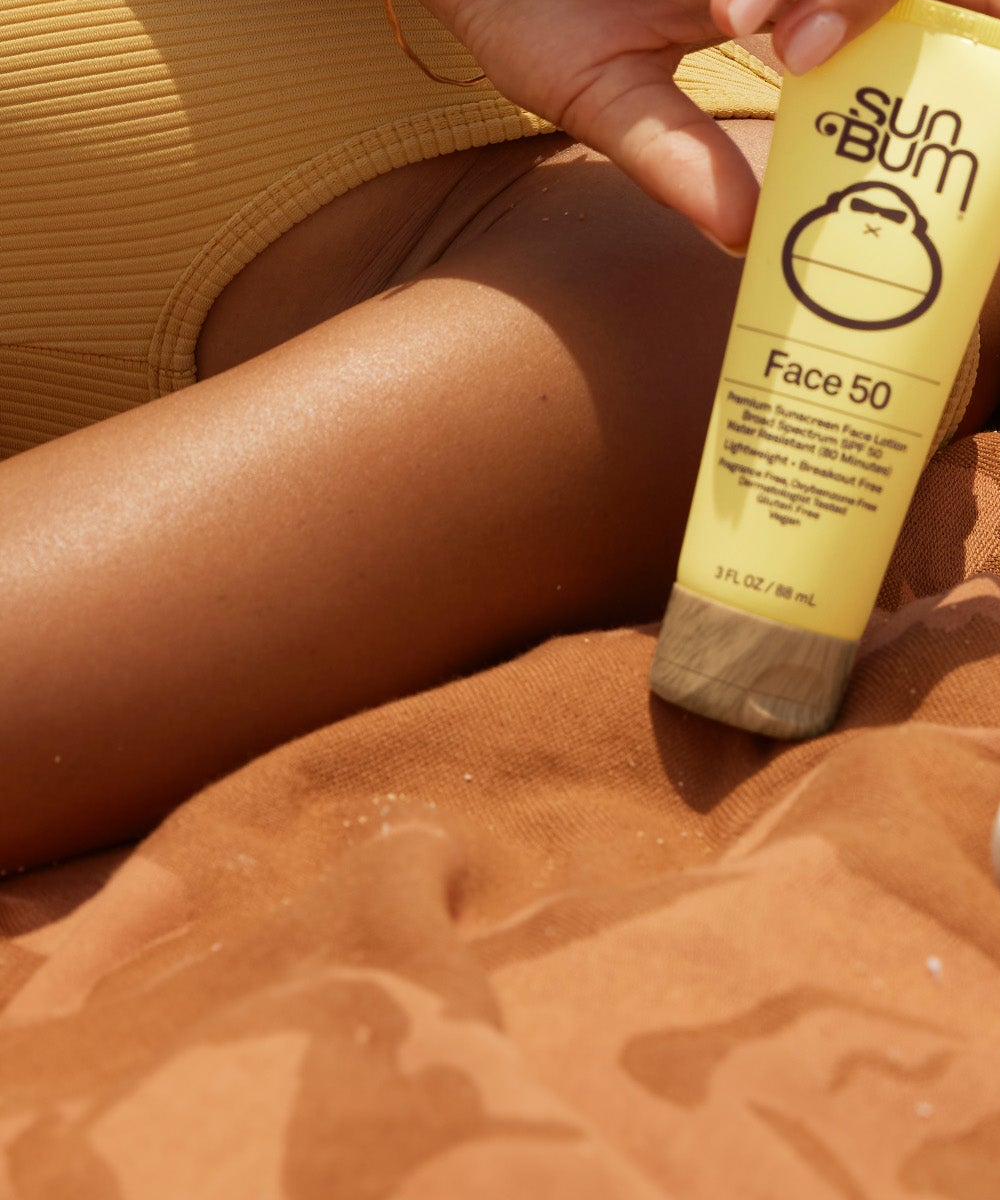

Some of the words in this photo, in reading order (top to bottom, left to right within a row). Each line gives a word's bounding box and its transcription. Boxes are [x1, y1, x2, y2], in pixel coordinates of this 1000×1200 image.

[763, 348, 842, 396] Face
[849, 374, 892, 411] 50
[742, 409, 775, 427] Broad
[778, 420, 839, 445] Spectrum
[841, 438, 866, 453] SPF
[867, 446, 884, 460] 50
[775, 405, 840, 431] Sunscreen
[842, 424, 873, 442] Face
[874, 431, 909, 452] Lotion
[857, 477, 884, 494] Free
[714, 566, 724, 579] 3
[724, 568, 740, 585] FL
[743, 574, 765, 592] OZ
[795, 591, 817, 608] mL
